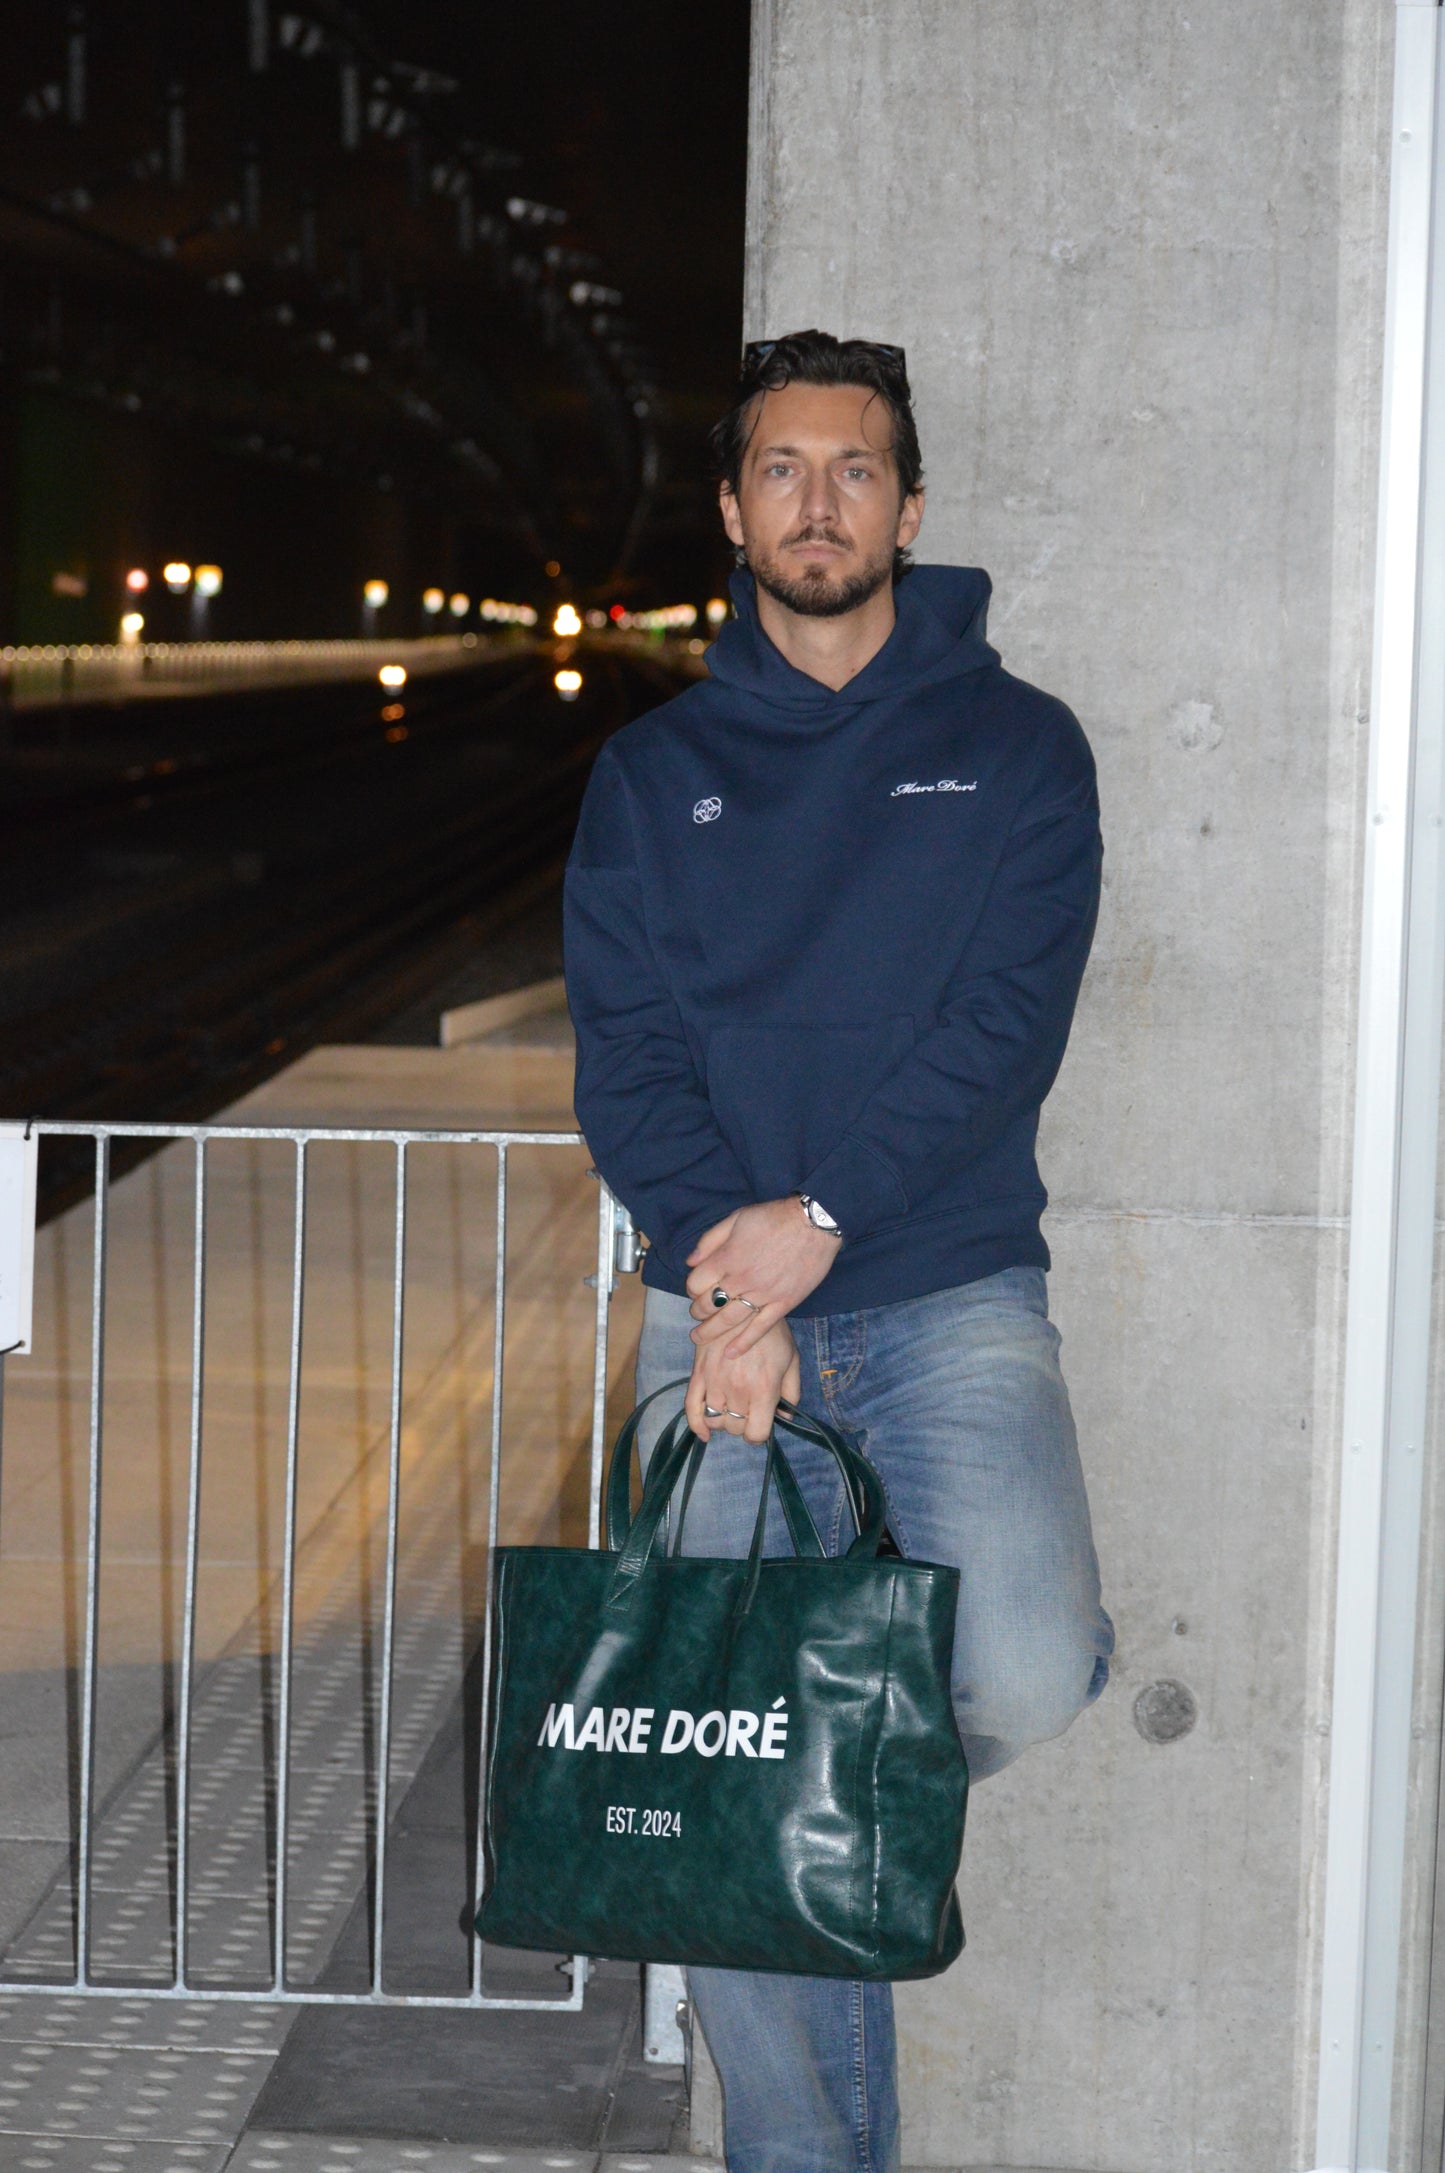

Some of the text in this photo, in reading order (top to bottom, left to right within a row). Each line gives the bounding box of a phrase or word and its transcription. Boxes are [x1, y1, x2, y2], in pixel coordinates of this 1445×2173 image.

[890, 779, 978, 797] Mare Doré
[537, 1695, 789, 1759] MARE DORÉ
[606, 1805, 681, 1838] EST. 2024
